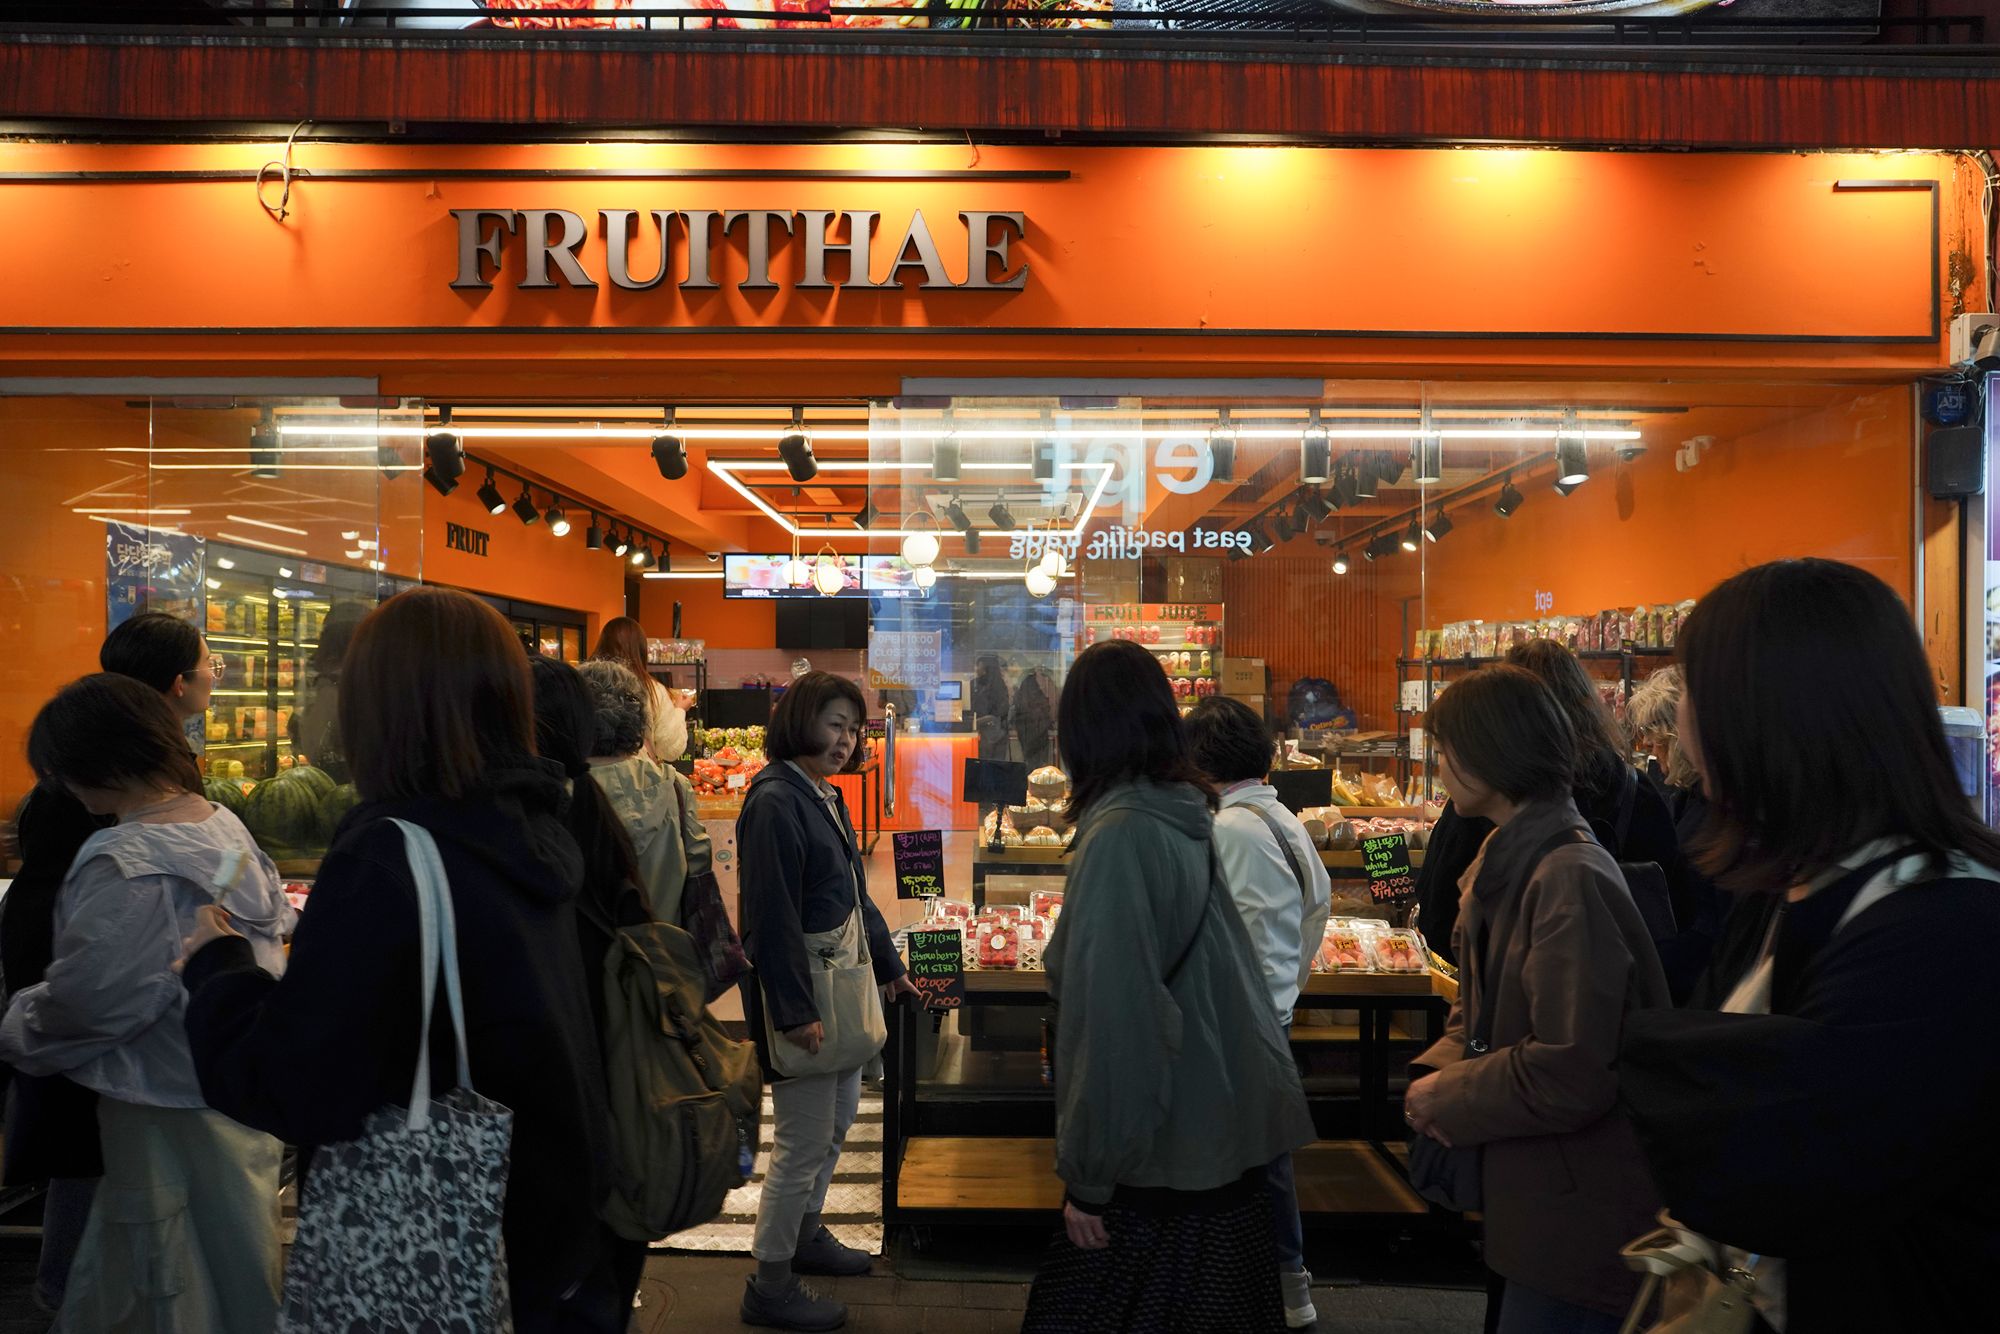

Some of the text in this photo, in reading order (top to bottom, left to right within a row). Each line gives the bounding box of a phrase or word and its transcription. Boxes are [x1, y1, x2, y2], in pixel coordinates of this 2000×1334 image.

[448, 208, 1030, 291] FRUITHAE
[446, 521, 489, 557] FRUIT
[1094, 605, 1207, 620] FRUIT JUICE
[874, 647, 906, 657] CLOSE
[903, 663, 936, 673] ORDER
